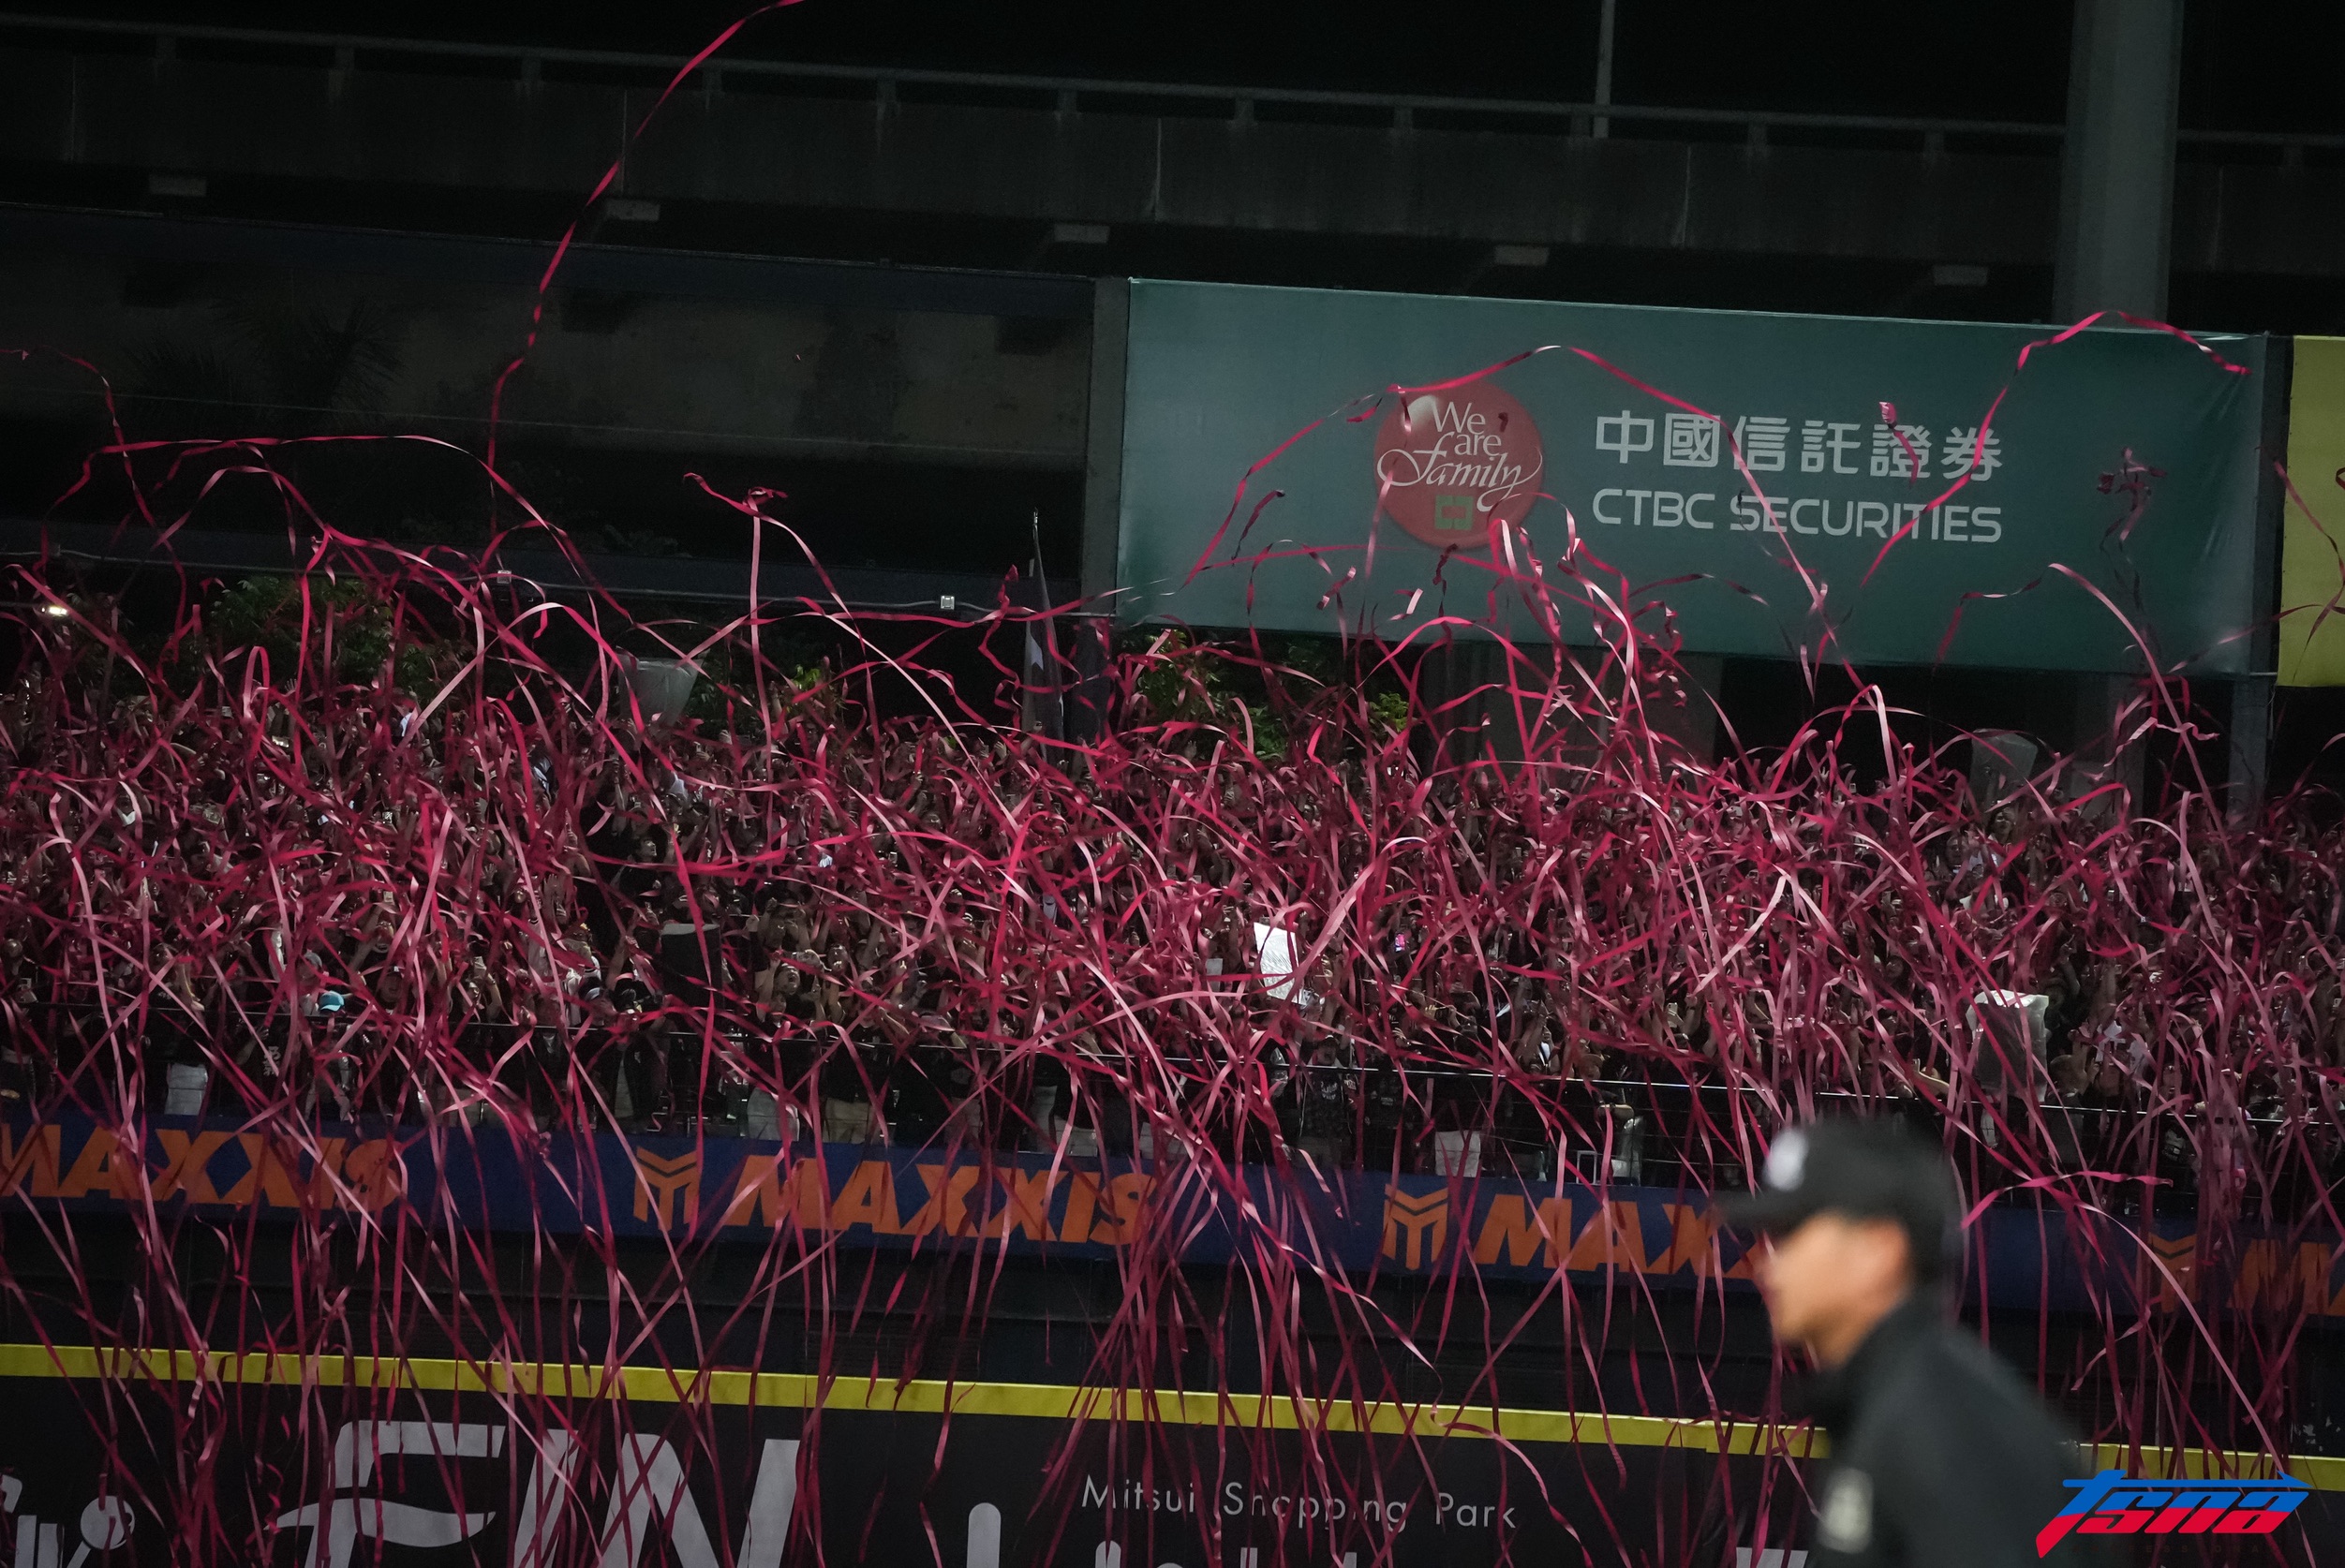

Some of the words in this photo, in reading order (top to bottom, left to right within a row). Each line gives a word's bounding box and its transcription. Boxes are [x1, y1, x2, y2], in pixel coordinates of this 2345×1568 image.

[1431, 401, 1486, 434] We
[1454, 434, 1502, 456] are
[1595, 409, 2004, 482] 中國信託證券
[1593, 488, 1715, 530] CTBC
[1729, 496, 2002, 543] SECURITIES
[722, 1154, 1158, 1246] MAXXIS
[1081, 1474, 1195, 1514] Mitsui
[1223, 1482, 1408, 1532] Shoppng
[1434, 1492, 1517, 1529] Park
